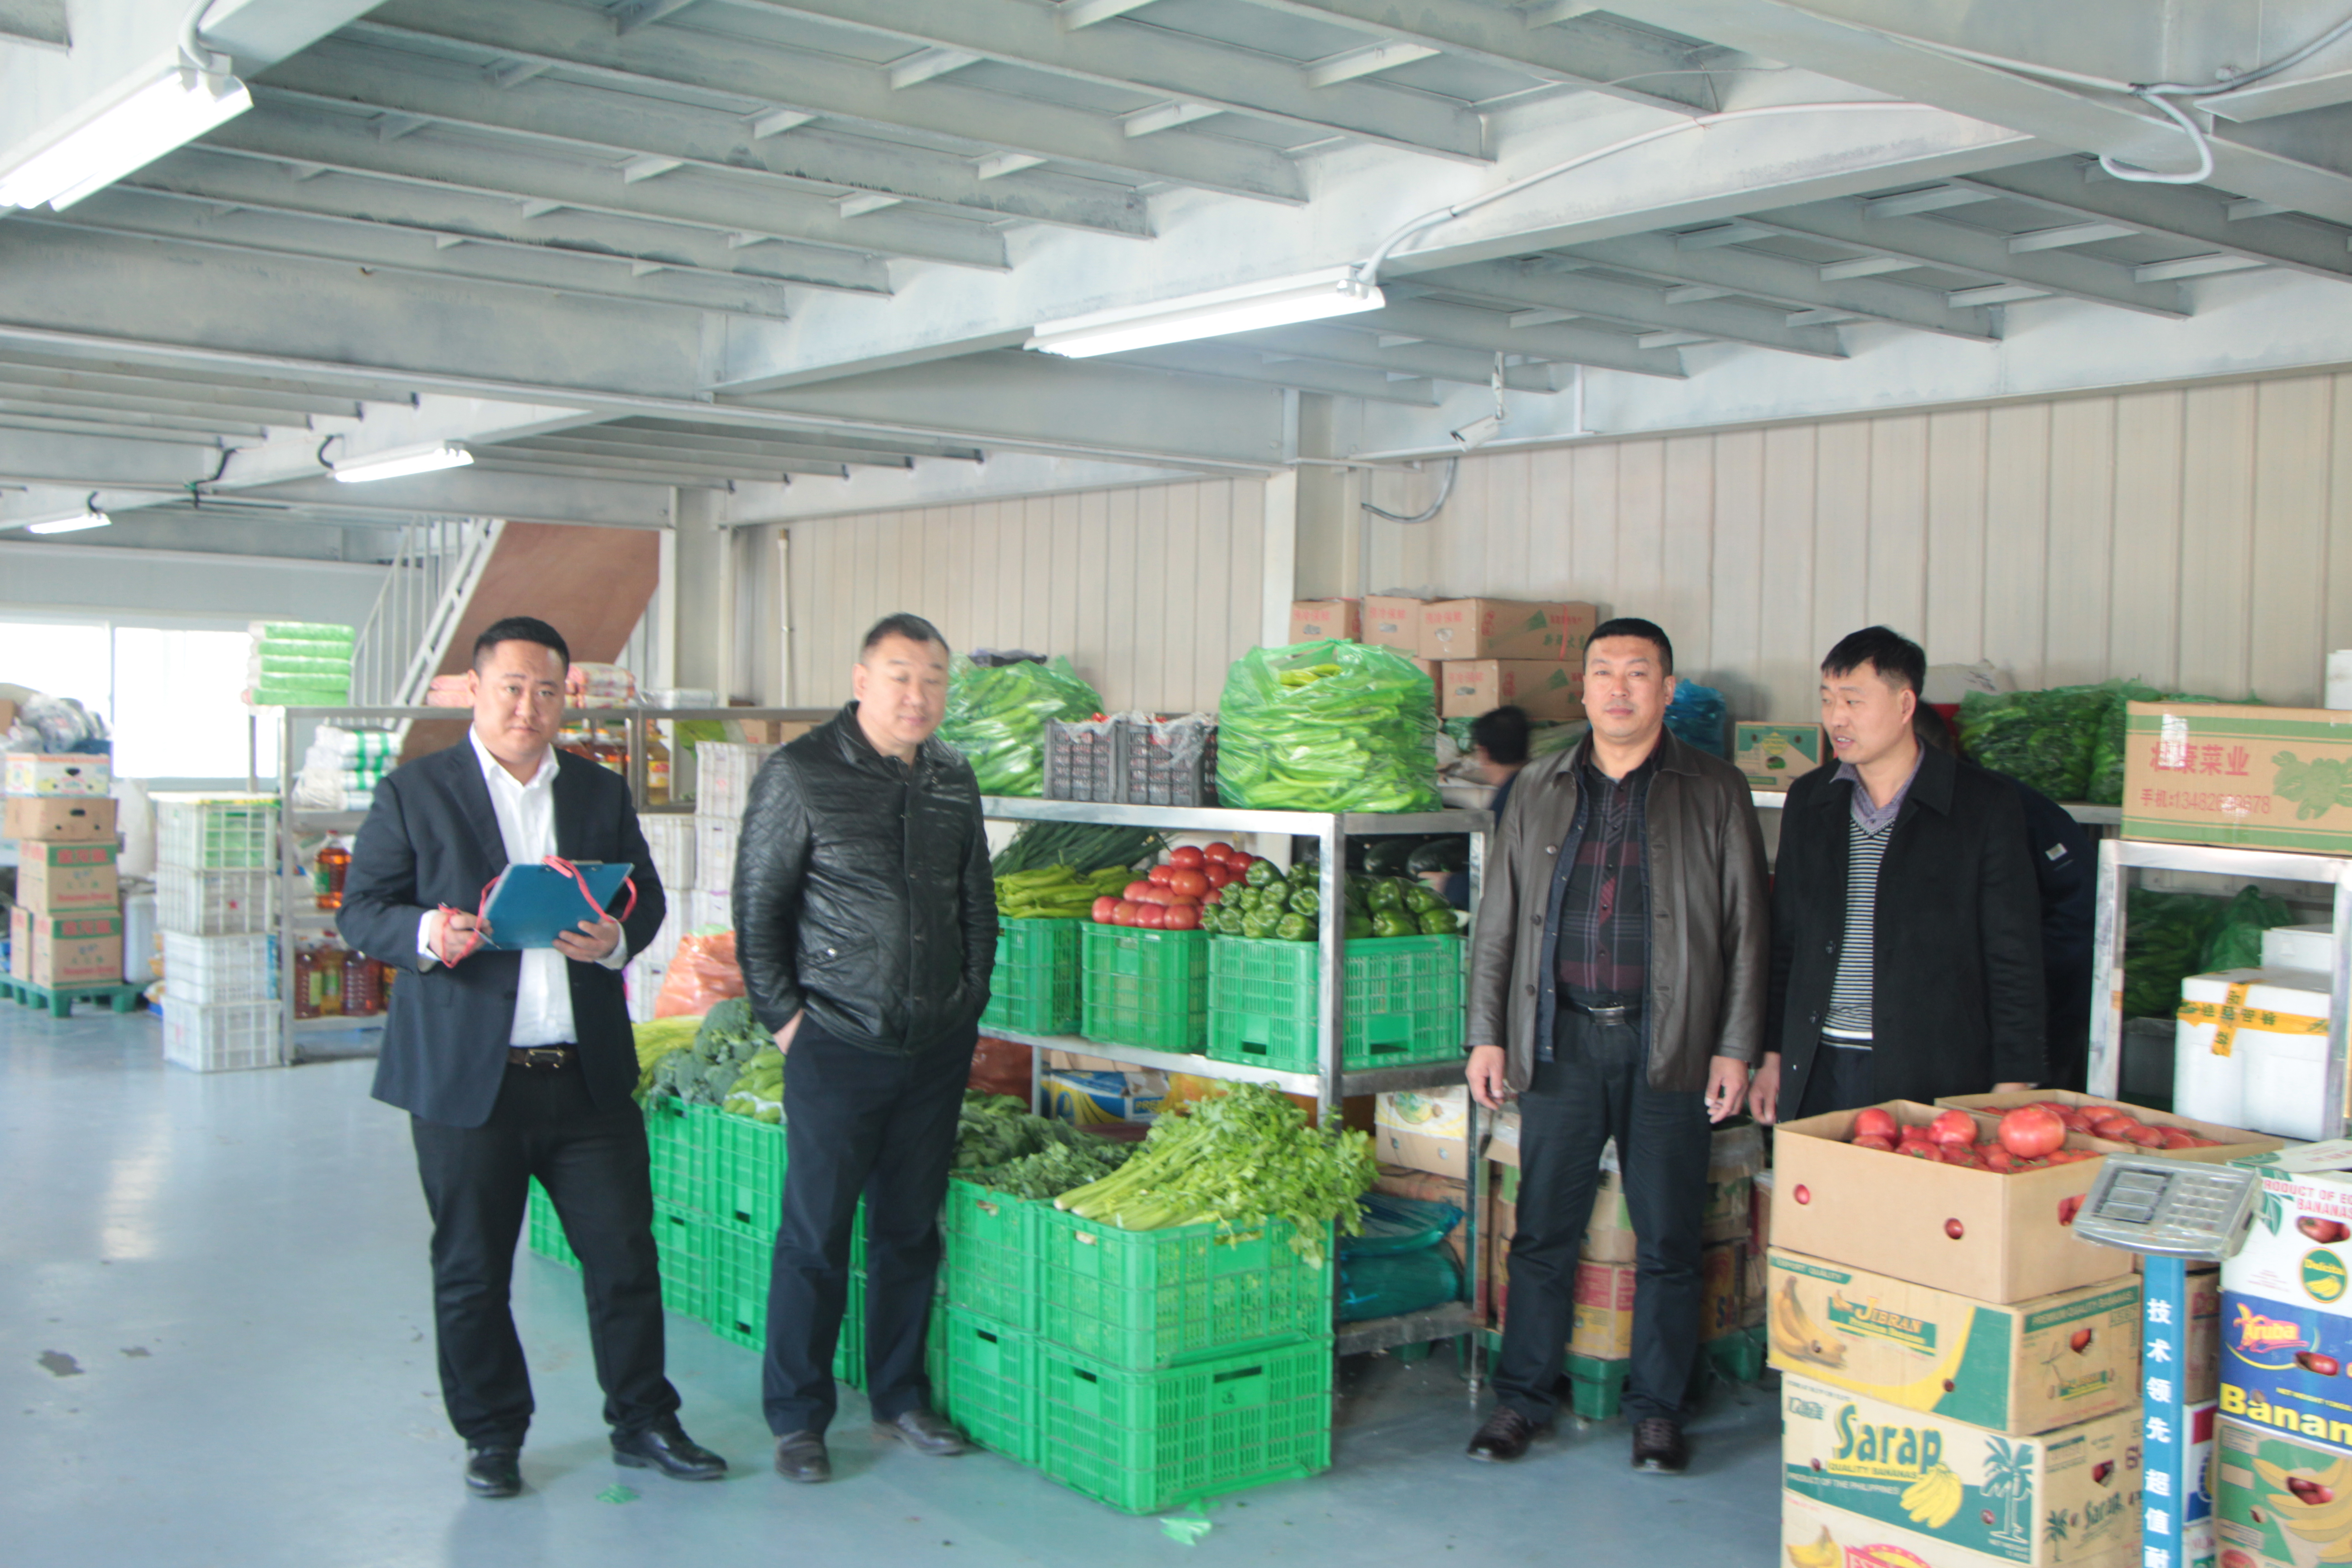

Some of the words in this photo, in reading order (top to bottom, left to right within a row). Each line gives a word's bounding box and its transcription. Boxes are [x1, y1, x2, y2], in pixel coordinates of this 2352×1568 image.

[2263, 1180, 2314, 1197] RODUCT
[2319, 1189, 2335, 1201] OF
[2239, 1318, 2299, 1345] Aruba
[2146, 1298, 2172, 1443] 技术领先
[1836, 1402, 1942, 1475] Sarap
[1828, 1462, 1868, 1474] QUALITY
[1872, 1467, 1916, 1479] BANANAS
[1820, 1477, 1832, 1486] OF
[1833, 1479, 1849, 1489] THE
